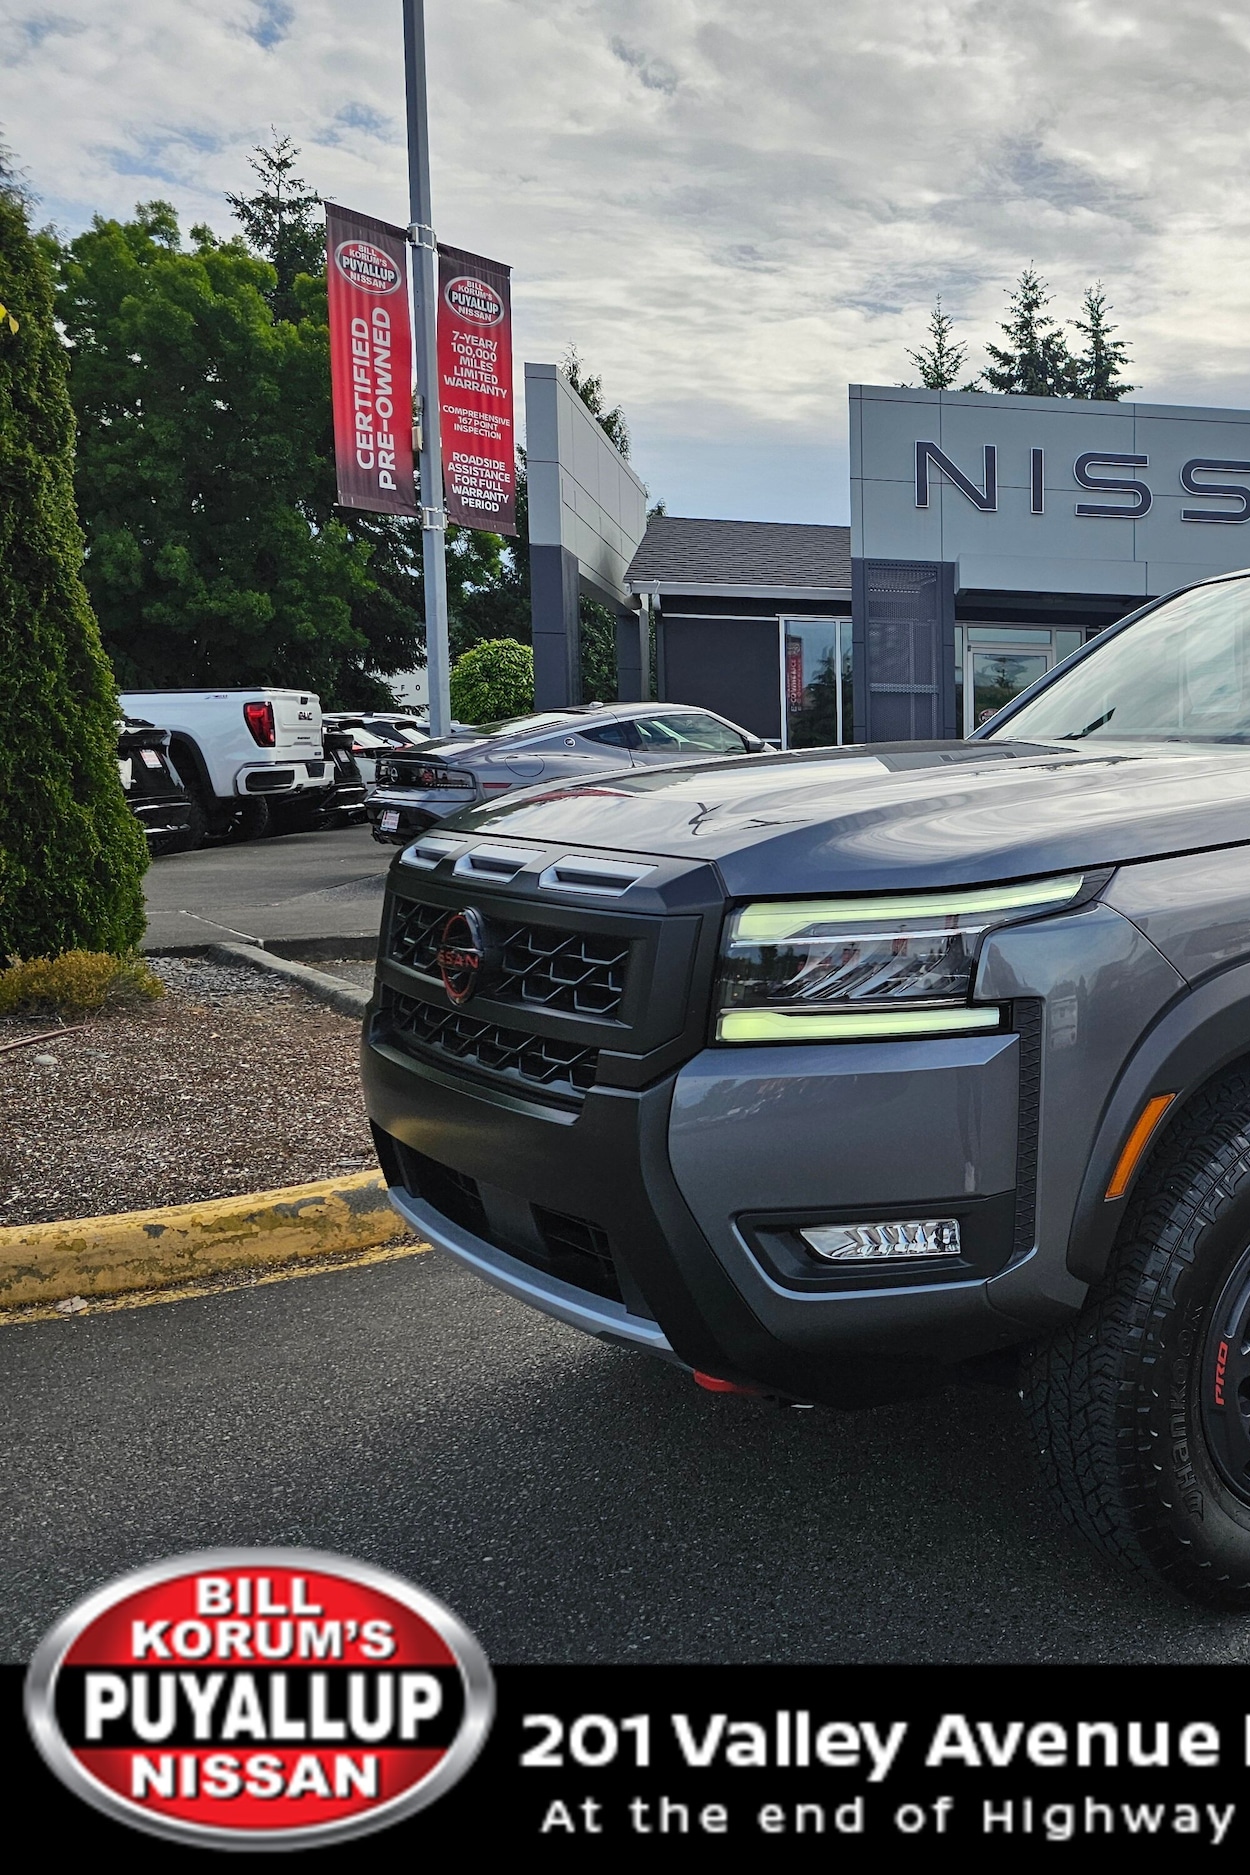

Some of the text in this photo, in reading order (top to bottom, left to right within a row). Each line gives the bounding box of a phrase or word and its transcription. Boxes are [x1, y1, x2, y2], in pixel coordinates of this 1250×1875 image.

[349, 249, 388, 267] KORUM'S
[358, 244, 377, 256] BILL
[342, 255, 395, 282] PUYALLUP
[350, 271, 386, 289] NISSAN
[466, 280, 484, 291] BILL
[451, 290, 499, 315] PUYALLUP
[458, 306, 492, 322] NISSAN
[452, 330, 498, 352] 7-YEAR/
[451, 341, 497, 363] 100,000
[459, 355, 494, 373] MILES
[453, 365, 498, 385] LIMITED
[351, 317, 375, 470] CERTIFIED
[443, 374, 508, 399] WARRANTY
[371, 306, 397, 490] PRE-OWNED
[442, 404, 511, 427] COMPREHENSIVE
[457, 416, 499, 431] 167 POINT
[453, 423, 502, 441] INSPECTION
[452, 451, 506, 471] ROADSIDE
[447, 461, 511, 483] ASSISTANCE
[454, 473, 504, 492] FOR FULL
[451, 483, 509, 504] WARRANTY
[461, 496, 500, 512] PERIOD
[1214, 1340, 1229, 1406] PRO
